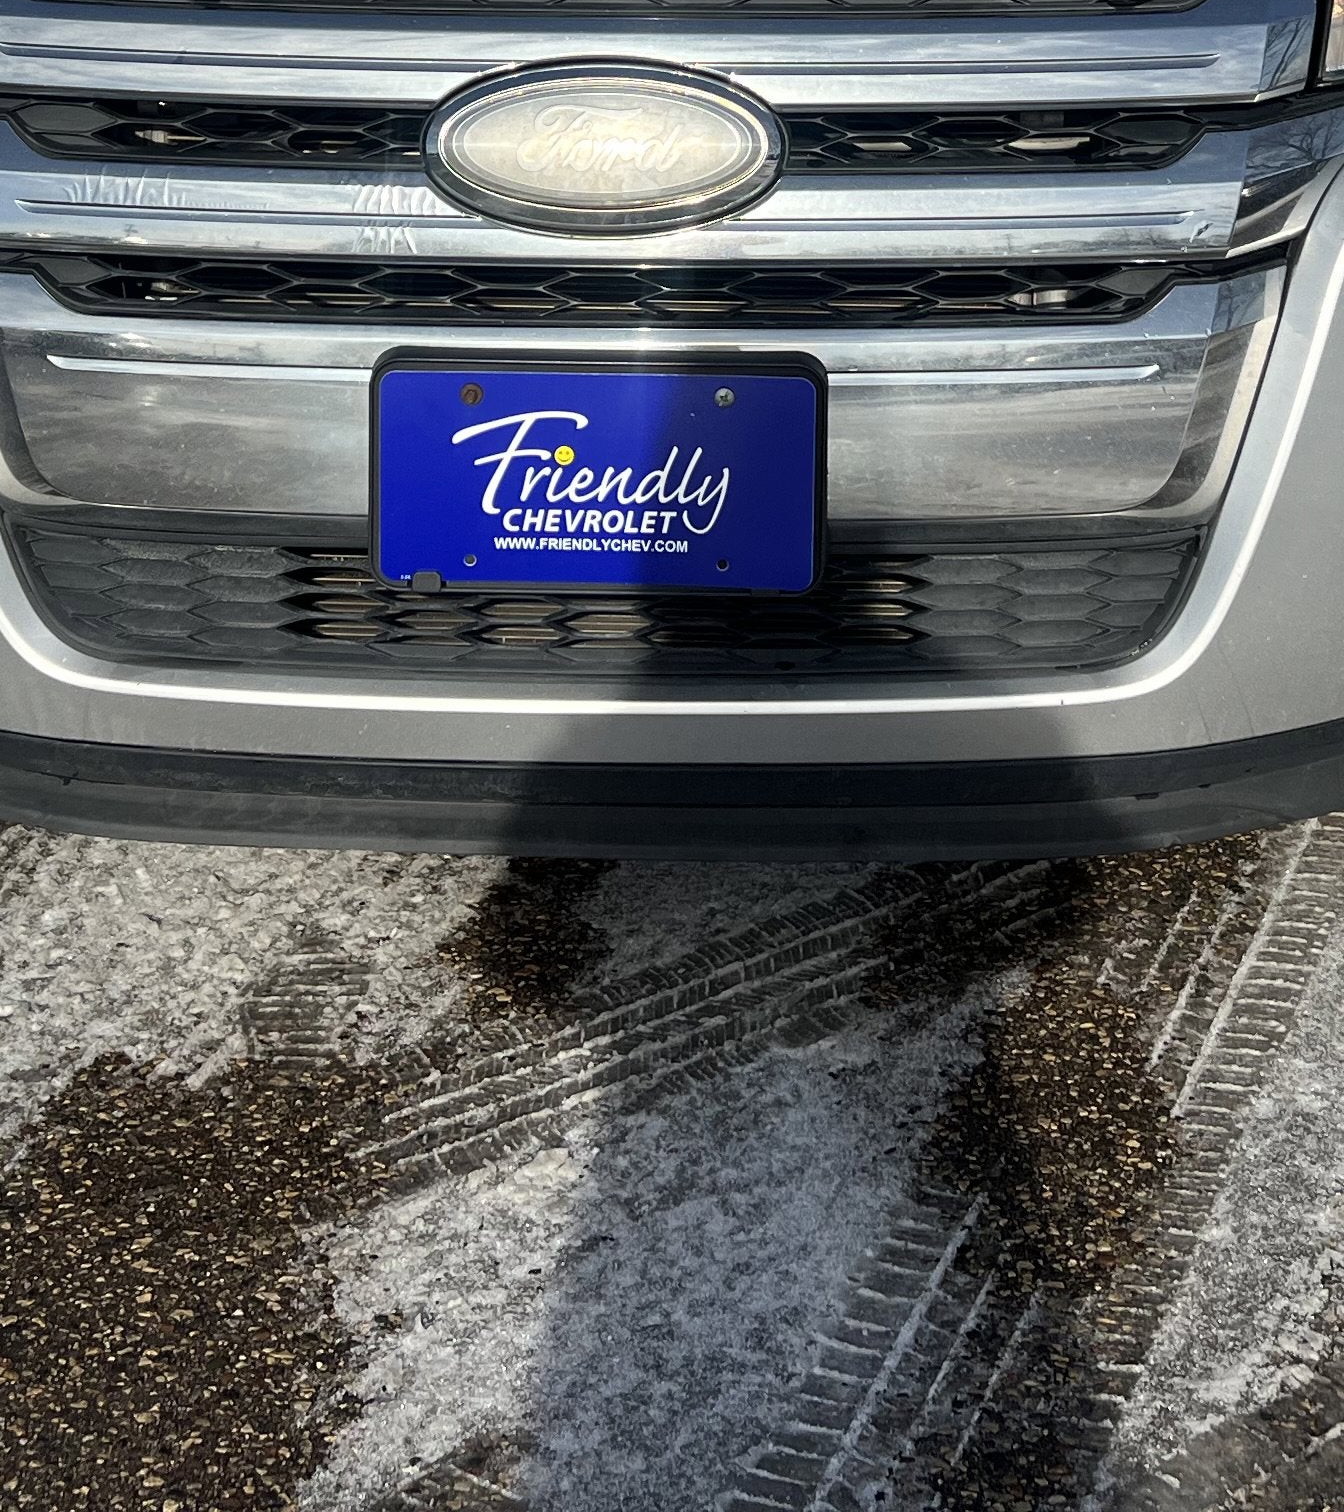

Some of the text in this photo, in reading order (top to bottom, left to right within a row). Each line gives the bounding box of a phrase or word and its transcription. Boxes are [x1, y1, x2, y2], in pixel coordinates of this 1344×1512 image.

[516, 104, 683, 172] Ford
[452, 411, 730, 534] Friendly
[494, 536, 689, 554] WWW.FRIENDLYCHEV.COM
[503, 508, 677, 535] CHEVROLET
